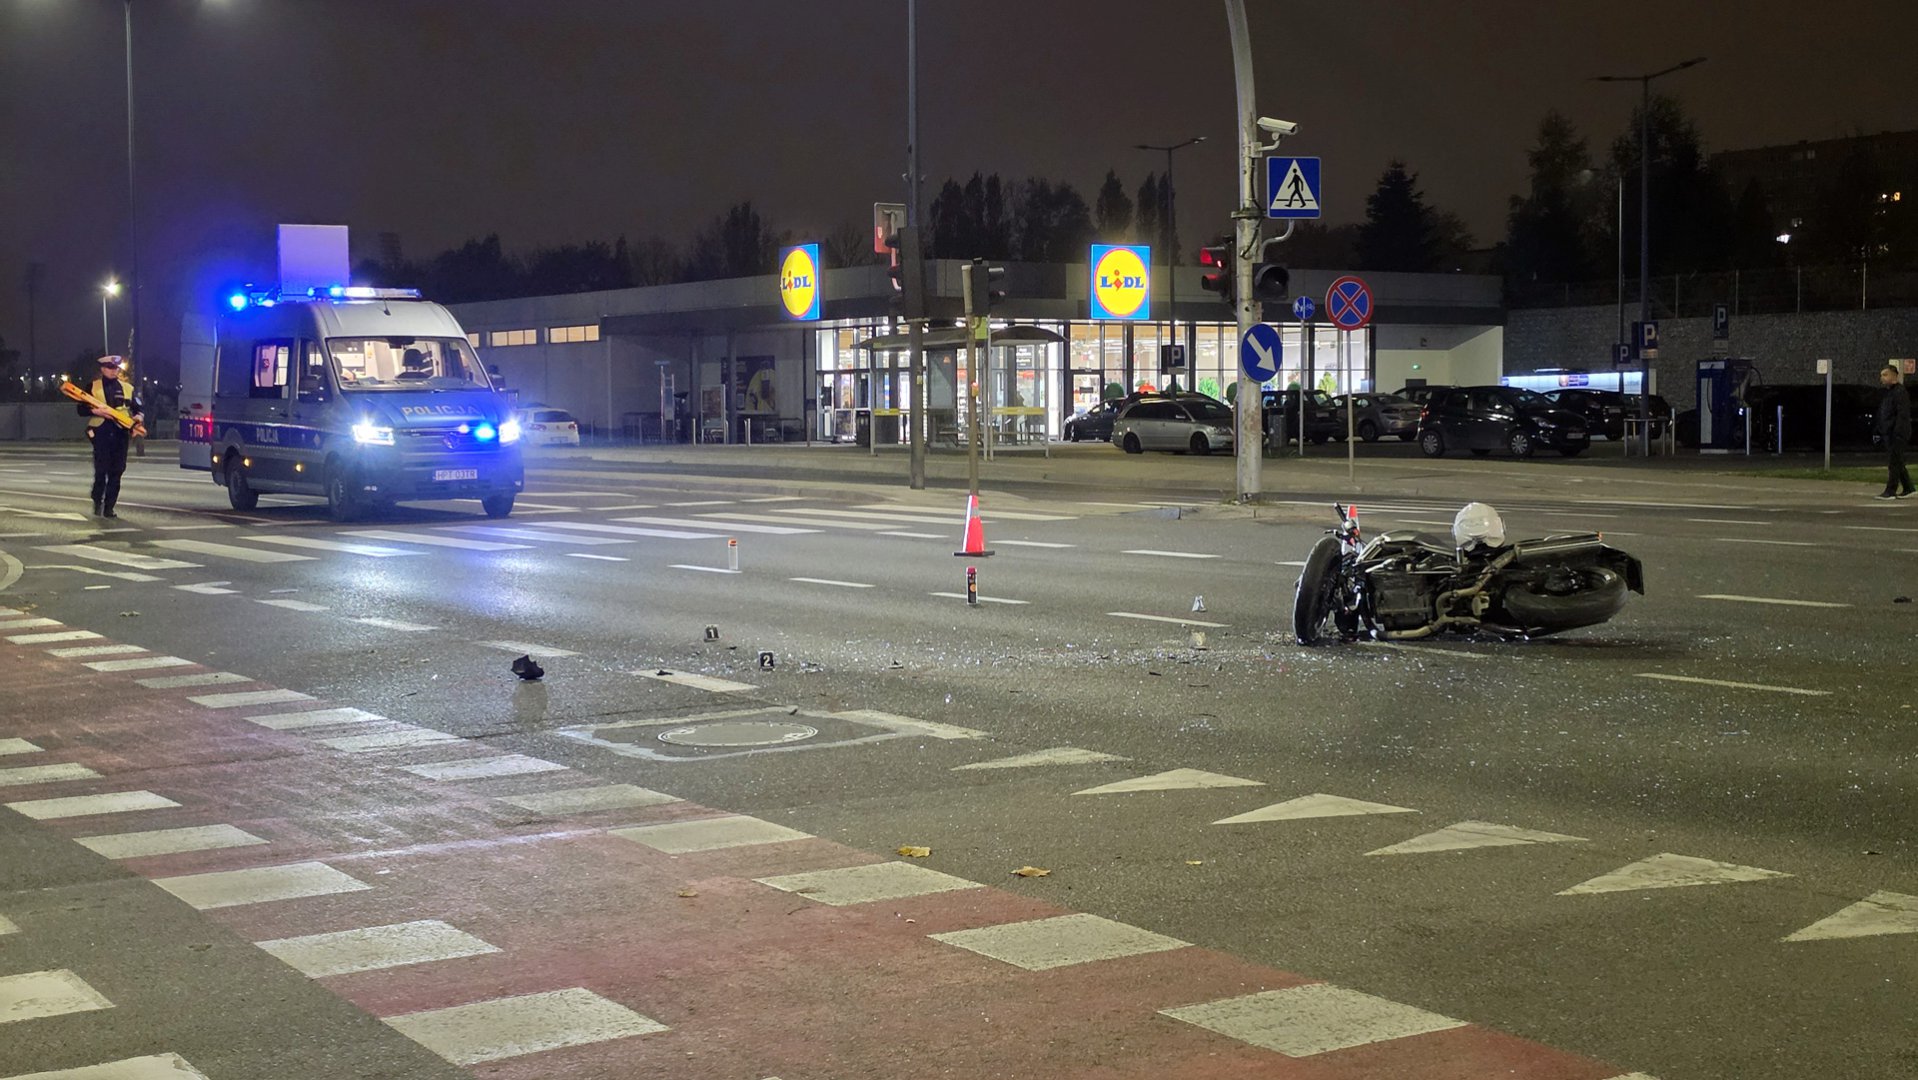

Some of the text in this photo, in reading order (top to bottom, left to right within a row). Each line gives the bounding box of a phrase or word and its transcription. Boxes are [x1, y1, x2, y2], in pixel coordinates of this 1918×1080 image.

[1717, 307, 1726, 329] P
[1643, 323, 1656, 346] P
[1172, 347, 1181, 364] P
[1620, 346, 1629, 361] P
[402, 405, 480, 416] POLICJA
[256, 427, 280, 444] POLICJA
[763, 655, 771, 667] 2
